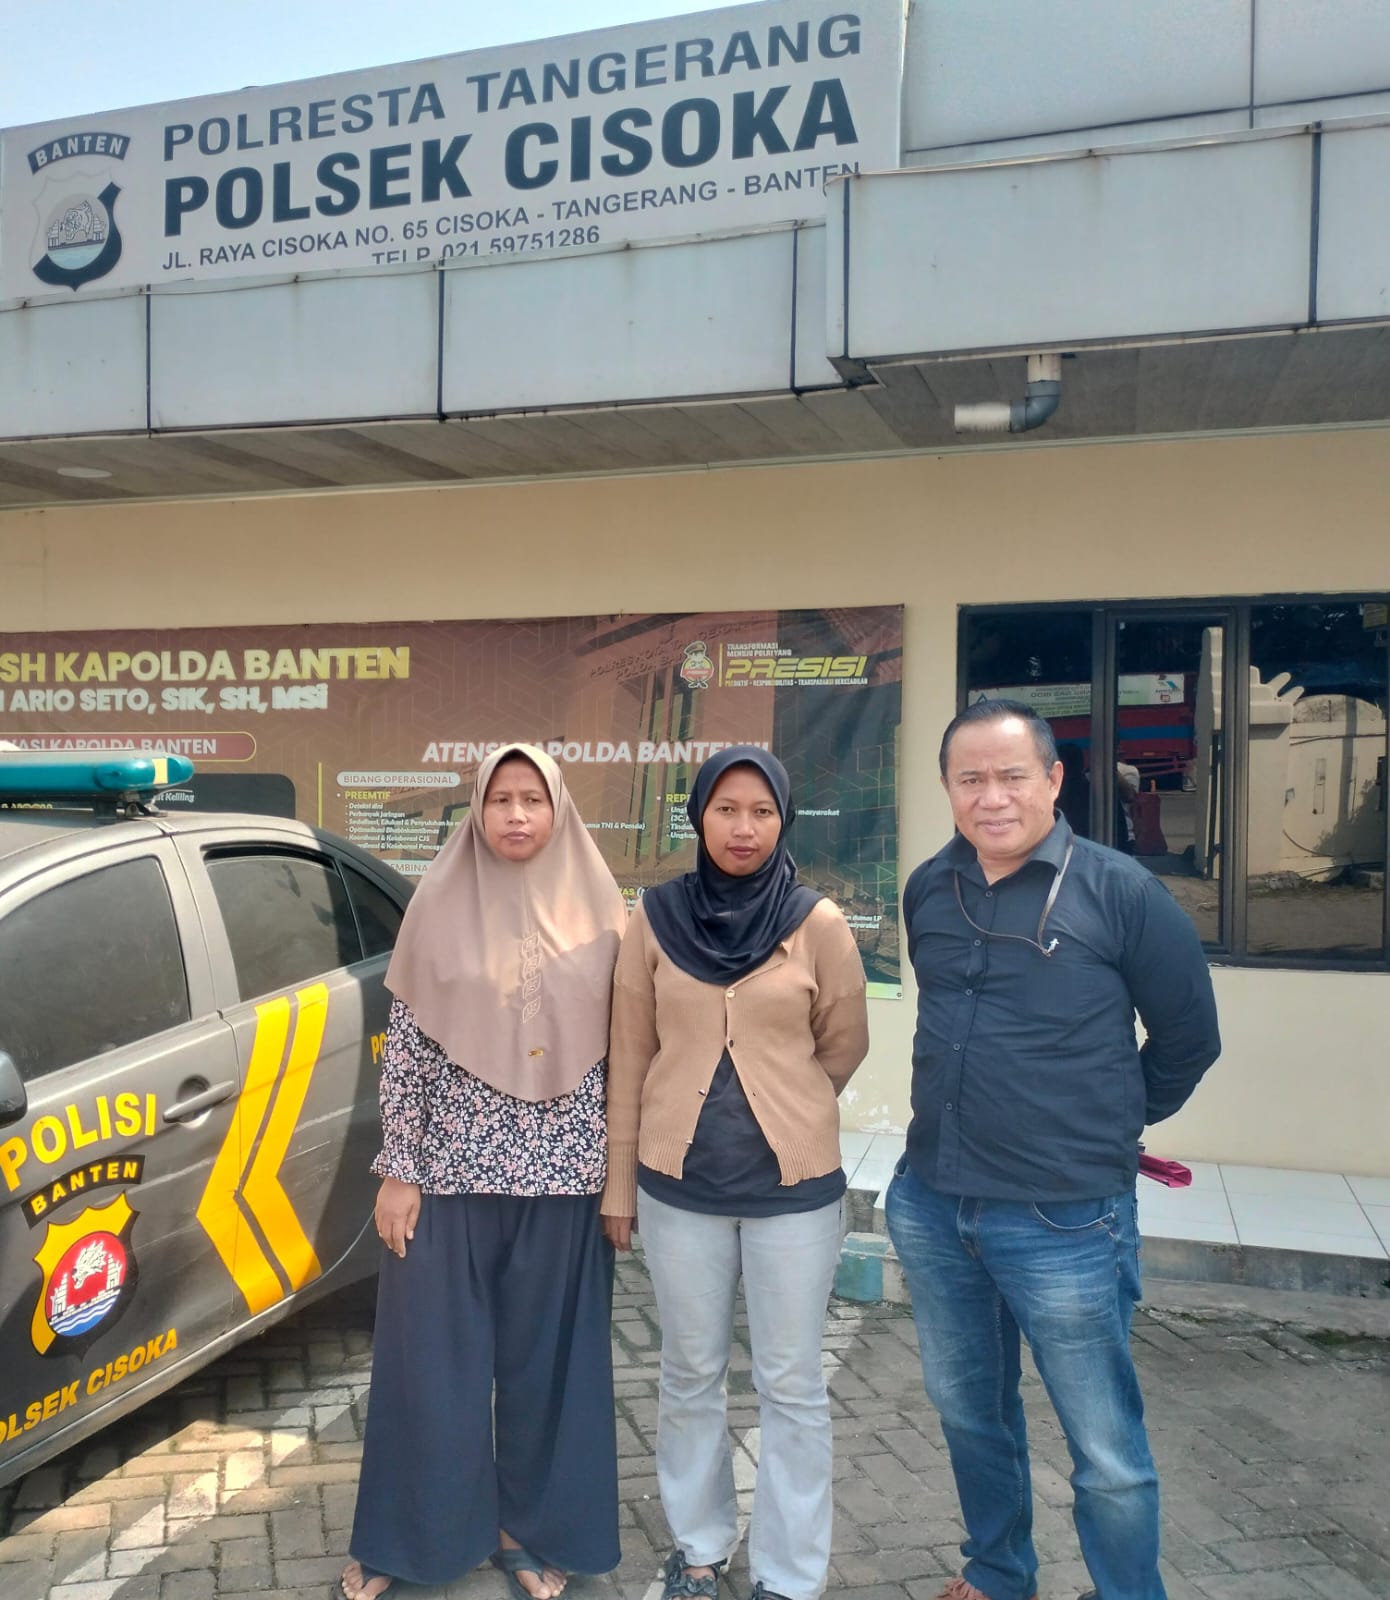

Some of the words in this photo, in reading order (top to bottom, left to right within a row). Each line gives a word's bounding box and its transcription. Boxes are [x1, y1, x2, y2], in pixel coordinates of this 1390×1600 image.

[163, 82, 446, 162] POLRESTA
[466, 13, 861, 114] TANGERANG
[34, 135, 123, 168] BANTEN
[164, 134, 473, 238] POLSEK
[504, 78, 859, 191] CISOKA
[162, 252, 192, 270] JL.
[200, 243, 256, 266] RAYA
[262, 230, 348, 258] CISOKA
[355, 225, 395, 246] NO.
[402, 220, 428, 240] 65
[435, 207, 530, 236] CISOKA
[552, 181, 718, 220] TANGERANG
[55, 649, 236, 683] KAPOLDA
[244, 646, 410, 682] BANTEN
[725, 656, 868, 679] PRESISI
[9, 688, 75, 712] ARIO
[80, 687, 157, 714] SETO,
[219, 686, 268, 714] SH,
[141, 738, 217, 754] BANTEN
[421, 741, 507, 763] ATENS
[343, 775, 382, 784] BIDANG
[384, 775, 453, 784] OPERASIONAL
[344, 791, 391, 800] PREEMTIF
[0, 1091, 157, 1193] POLISI
[31, 1160, 138, 1216] BANTEN
[86, 1327, 178, 1396] CISOKA
